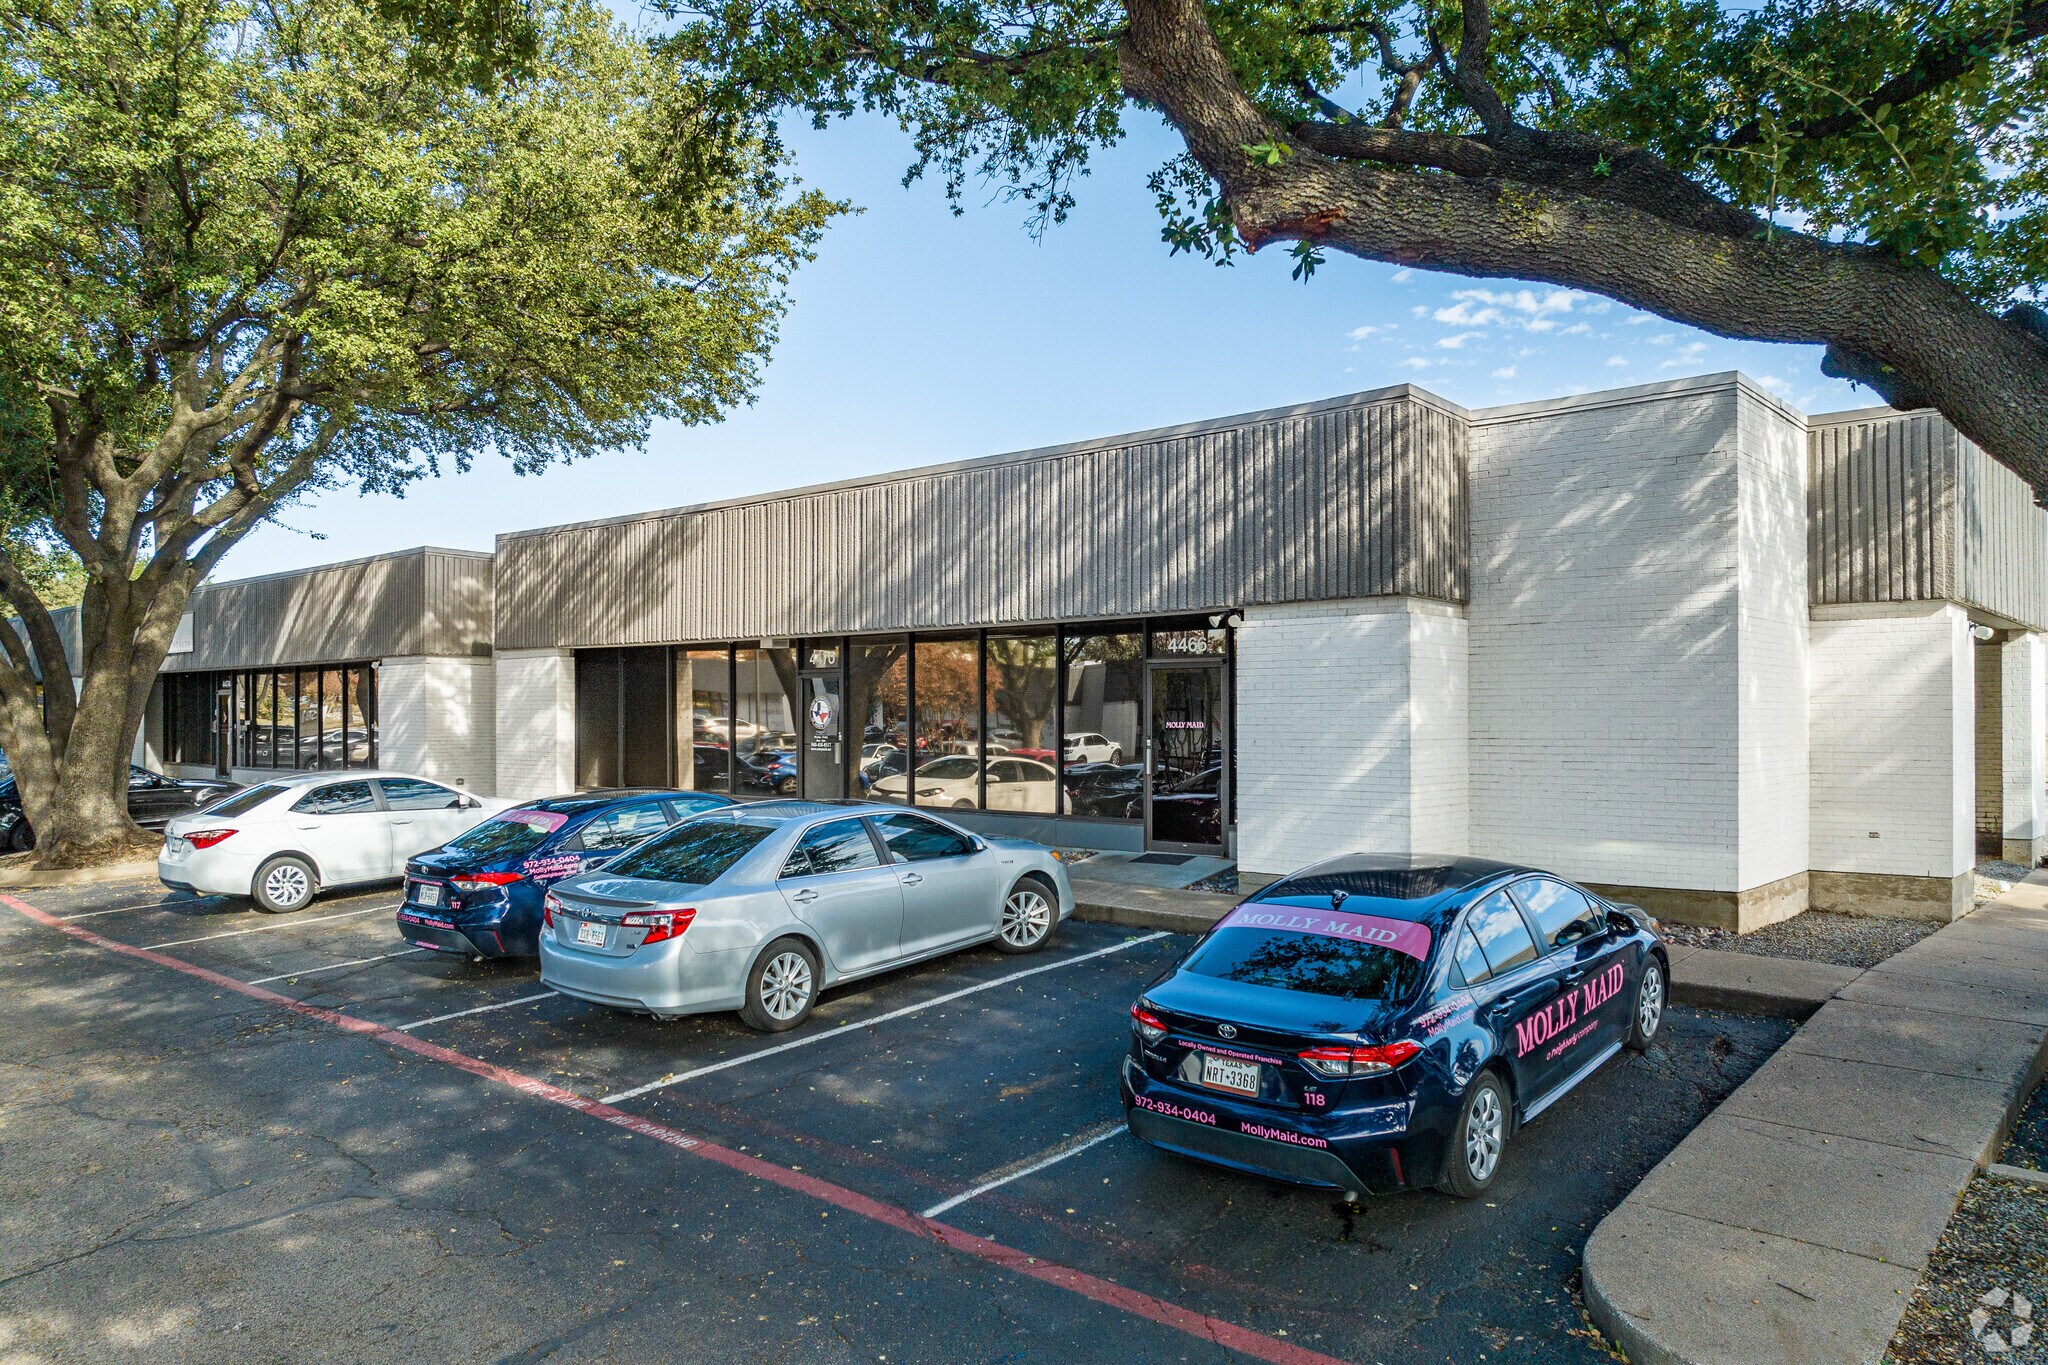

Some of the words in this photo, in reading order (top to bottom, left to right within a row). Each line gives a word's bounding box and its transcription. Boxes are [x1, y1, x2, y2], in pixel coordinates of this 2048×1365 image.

[1167, 637, 1207, 653] 4466
[809, 649, 836, 665] 4470
[1165, 721, 1186, 729] MOLLY
[523, 854, 580, 869] 972-934-0404
[529, 862, 579, 875] MollyMaid.com
[450, 901, 461, 910] 117
[424, 919, 455, 930] MollyMaid.com
[1236, 913, 1320, 930] MOLLY
[1323, 919, 1399, 943] MAID
[1419, 995, 1473, 1029] 972-934-0404
[1515, 990, 1578, 1058] MOLLY
[1584, 963, 1625, 1016] MAID
[1427, 1008, 1476, 1038] MollyMaid.com
[1551, 1032, 1578, 1058] neighborly
[1576, 1019, 1599, 1039] company
[1178, 1039, 1198, 1050] Locally
[1197, 1043, 1216, 1054] Owned
[1216, 1047, 1227, 1055] and
[1227, 1049, 1254, 1061] Operated
[1254, 1053, 1283, 1066] Franchise
[1221, 1059, 1243, 1070] TEXAS
[1134, 1094, 1217, 1126] 972-934-0404
[1303, 1092, 1326, 1107] 118
[633, 1122, 698, 1149] PARKING
[1240, 1121, 1328, 1149] MollyMaid.com
